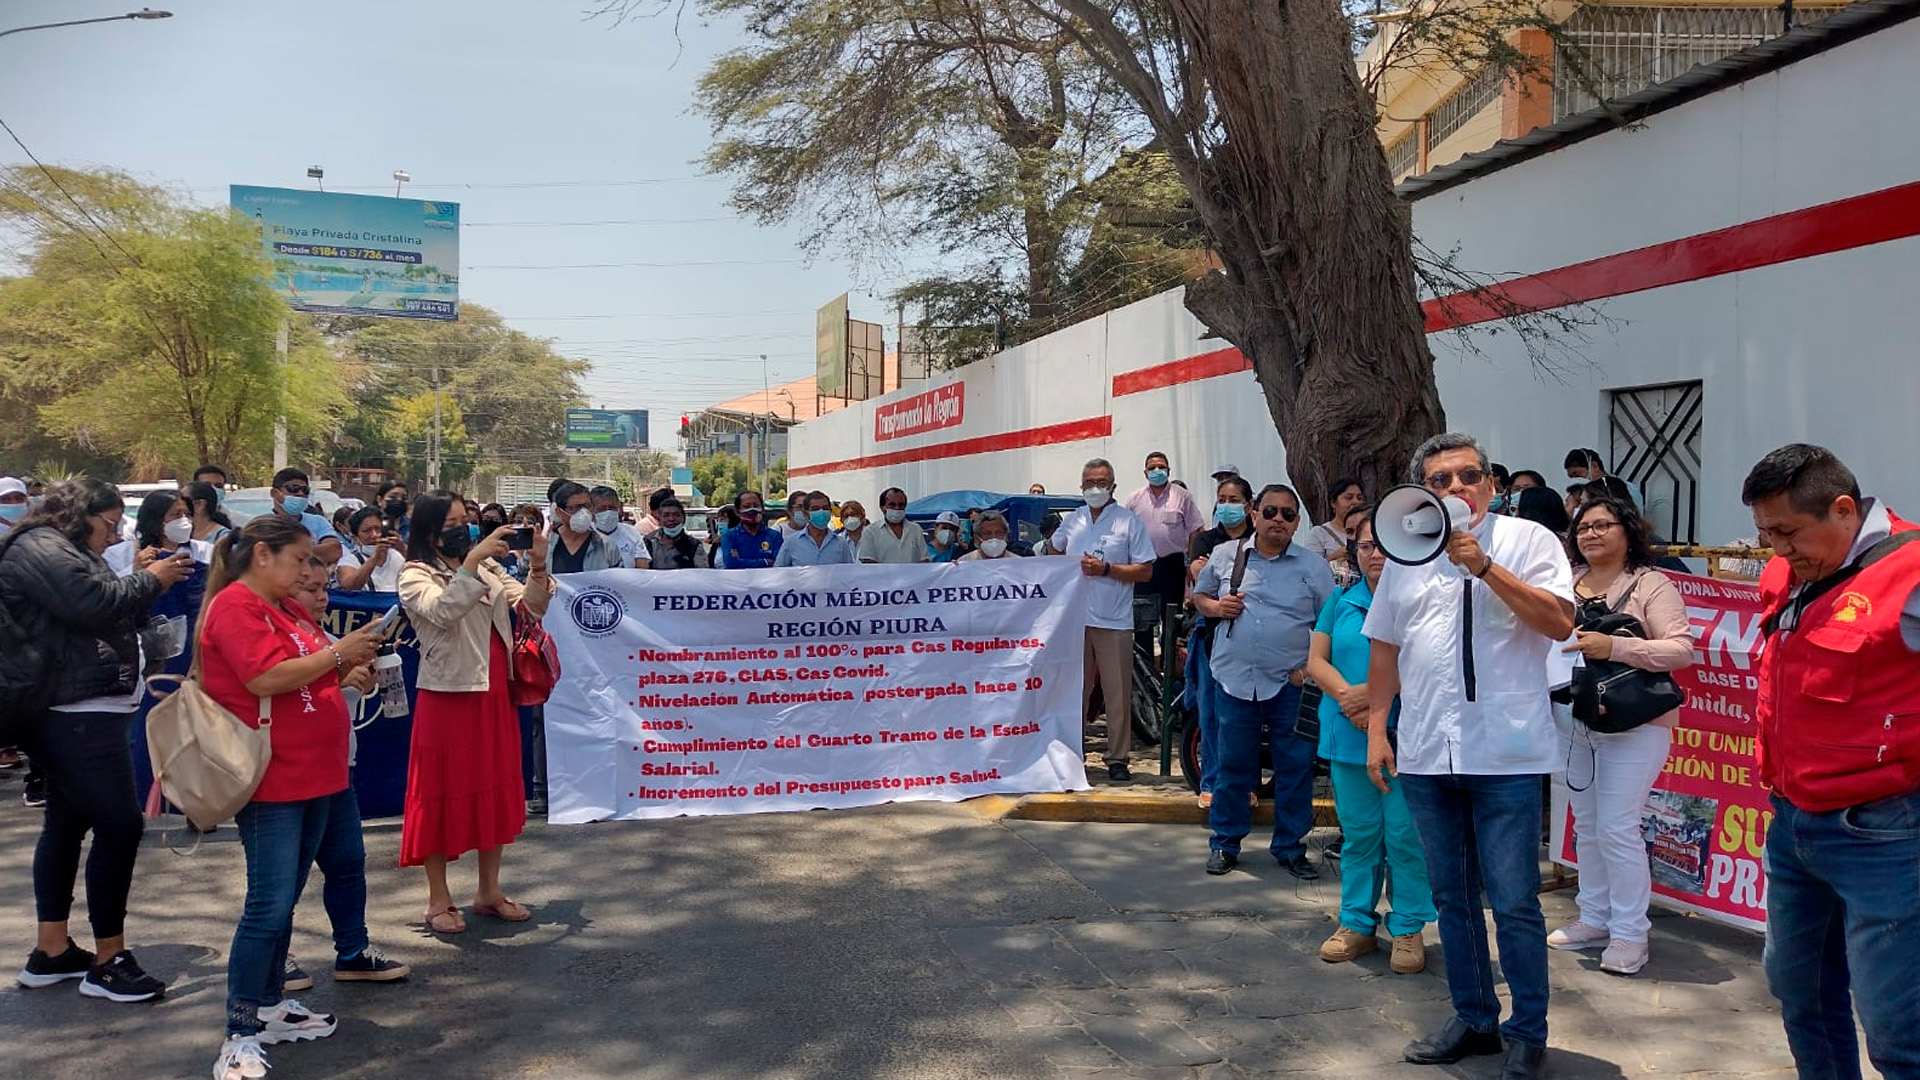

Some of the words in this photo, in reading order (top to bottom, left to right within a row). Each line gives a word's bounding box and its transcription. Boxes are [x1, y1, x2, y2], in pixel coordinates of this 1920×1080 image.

[312, 228, 358, 240] Privada
[362, 231, 422, 245] Cristalina
[280, 245, 310, 255] Desde
[878, 398, 923, 438] Transformando
[933, 386, 960, 425] Región
[653, 588, 817, 611] FEDERACIÓN
[825, 587, 921, 607] MÉDICA
[927, 583, 1047, 603] PERUANA
[767, 616, 863, 640] REGIÓN
[869, 616, 948, 636] PIURA
[638, 647, 778, 662] Nombramiento
[783, 645, 801, 659] al
[805, 644, 858, 658] 100%
[863, 643, 905, 659] para
[910, 640, 946, 653] Cas
[638, 671, 689, 688] plaza
[738, 668, 793, 683] CLAS,
[796, 667, 831, 680] Cas
[833, 664, 890, 679] Covid.
[1697, 669, 1741, 689] BASE
[638, 691, 738, 708] Nivelación
[974, 681, 1017, 695] hace
[1024, 677, 1043, 691] 10
[643, 737, 768, 755] Cumplimiento
[773, 735, 801, 749] del
[807, 732, 873, 748] Cuarto
[879, 729, 938, 744] Tramo
[943, 727, 965, 740] de
[970, 725, 987, 739] la
[993, 721, 1041, 737] Escala
[1669, 725, 1702, 748] TO
[641, 761, 720, 777] Salarial.
[1722, 763, 1752, 787] DE
[639, 785, 748, 800] Incremento
[753, 781, 781, 796] del
[786, 775, 902, 795] Presupuesto
[903, 774, 946, 790] para
[949, 768, 1002, 784] Salud.
